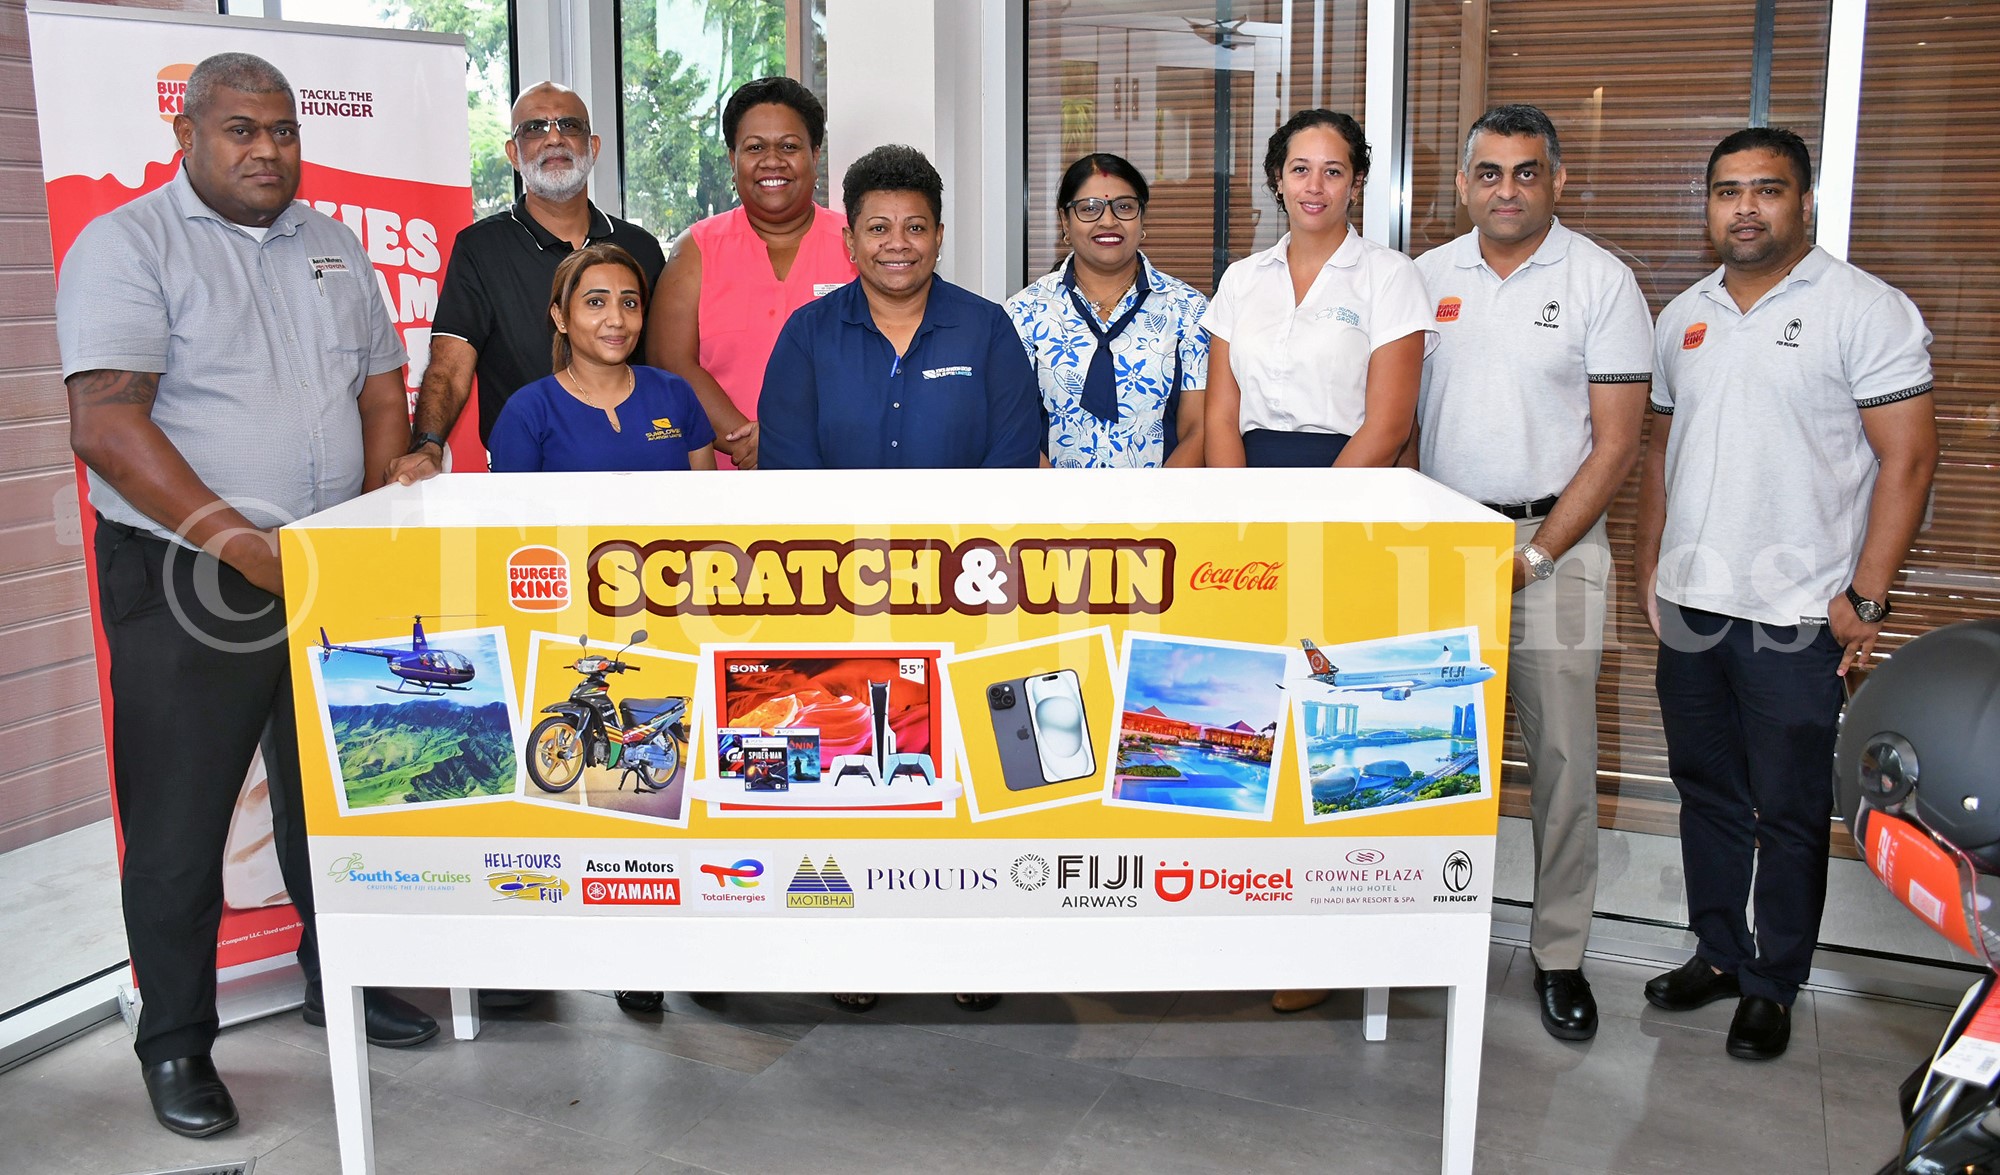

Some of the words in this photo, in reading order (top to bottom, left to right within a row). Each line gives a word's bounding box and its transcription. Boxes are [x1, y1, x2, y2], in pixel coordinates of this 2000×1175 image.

[300, 89, 347, 101] TACKLE
[348, 91, 373, 102] THE
[301, 101, 373, 118] HUNGER
[1435, 308, 1460, 318] KING
[1683, 333, 1704, 346] KING
[509, 566, 568, 580] BURGER
[596, 549, 942, 607] SCRATCH
[953, 548, 1008, 606] &
[1019, 548, 1165, 605] WIN
[1189, 561, 1286, 592] Coca-Cola
[511, 581, 568, 599] KING
[729, 664, 769, 672] SONY
[1441, 666, 1466, 678] FIJI
[748, 751, 783, 760] SPIDER-MAN
[484, 853, 562, 869] HELI-TOURS
[585, 859, 621, 873] Asco
[624, 860, 674, 873] Motors
[349, 870, 391, 882] South
[394, 871, 420, 882] Sea
[421, 871, 471, 883] Cruises
[1057, 854, 1144, 889] FIJI
[1305, 870, 1369, 882] CROWNE
[1375, 869, 1423, 881] PLAZA
[866, 867, 998, 890] PROUDS
[1199, 868, 1294, 895] Digicel
[607, 882, 676, 900] YAMAHA
[1367, 884, 1397, 892] HOTEL
[540, 887, 563, 903] Fiji
[701, 893, 766, 903] TotalEnergies
[790, 895, 852, 906] MOTIBHAI
[1061, 895, 1138, 908] AIRWAYS
[1245, 892, 1293, 901] PACIFIC
[1433, 895, 1448, 903] FIJI
[222, 935, 249, 946] Company
[263, 927, 279, 936] Used
[279, 923, 296, 932] under
